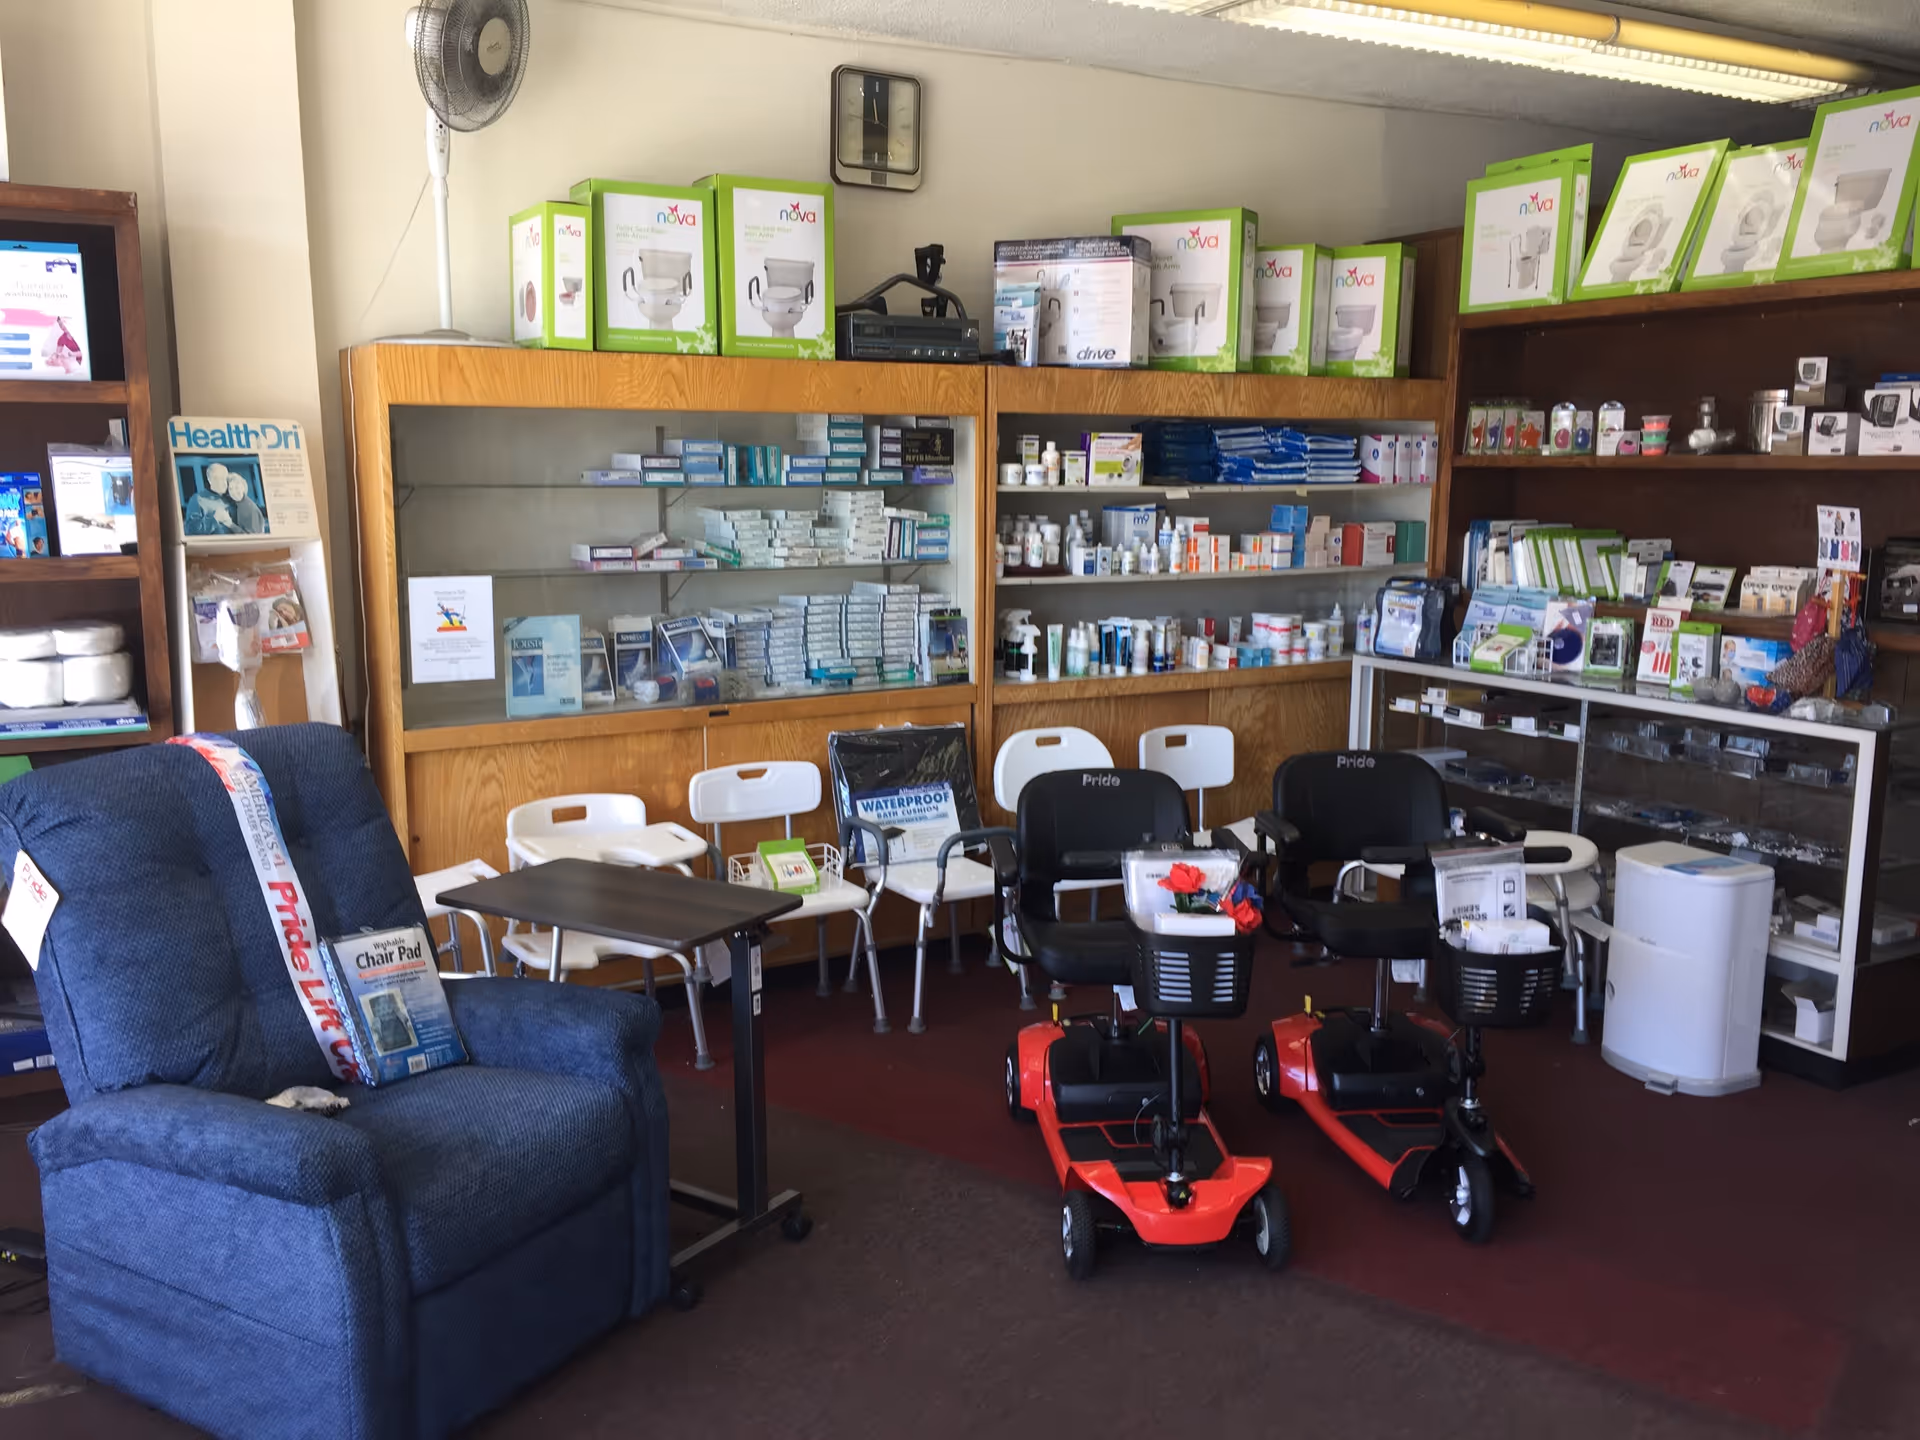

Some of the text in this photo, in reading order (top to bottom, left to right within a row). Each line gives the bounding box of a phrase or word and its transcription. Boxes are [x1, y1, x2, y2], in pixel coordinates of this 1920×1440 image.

[1868, 112, 1912, 132] nova
[1666, 165, 1700, 182] nova
[1519, 195, 1554, 215] nova
[656, 209, 696, 226] nova
[779, 206, 816, 223] nova
[1177, 231, 1219, 249] nova
[1256, 263, 1292, 278] nova
[1335, 270, 1376, 287] nova
[1076, 346, 1116, 361] drive
[1336, 754, 1376, 769] Pride
[1082, 772, 1121, 787] Pride
[861, 791, 949, 812] WATERPROOF
[877, 810, 898, 819] BATH
[902, 804, 939, 816] CUSHION
[373, 937, 405, 950] Washable
[267, 880, 313, 974] Pride
[298, 979, 344, 1033] Lift
[355, 949, 395, 970] Chair
[397, 941, 423, 961] Pad
